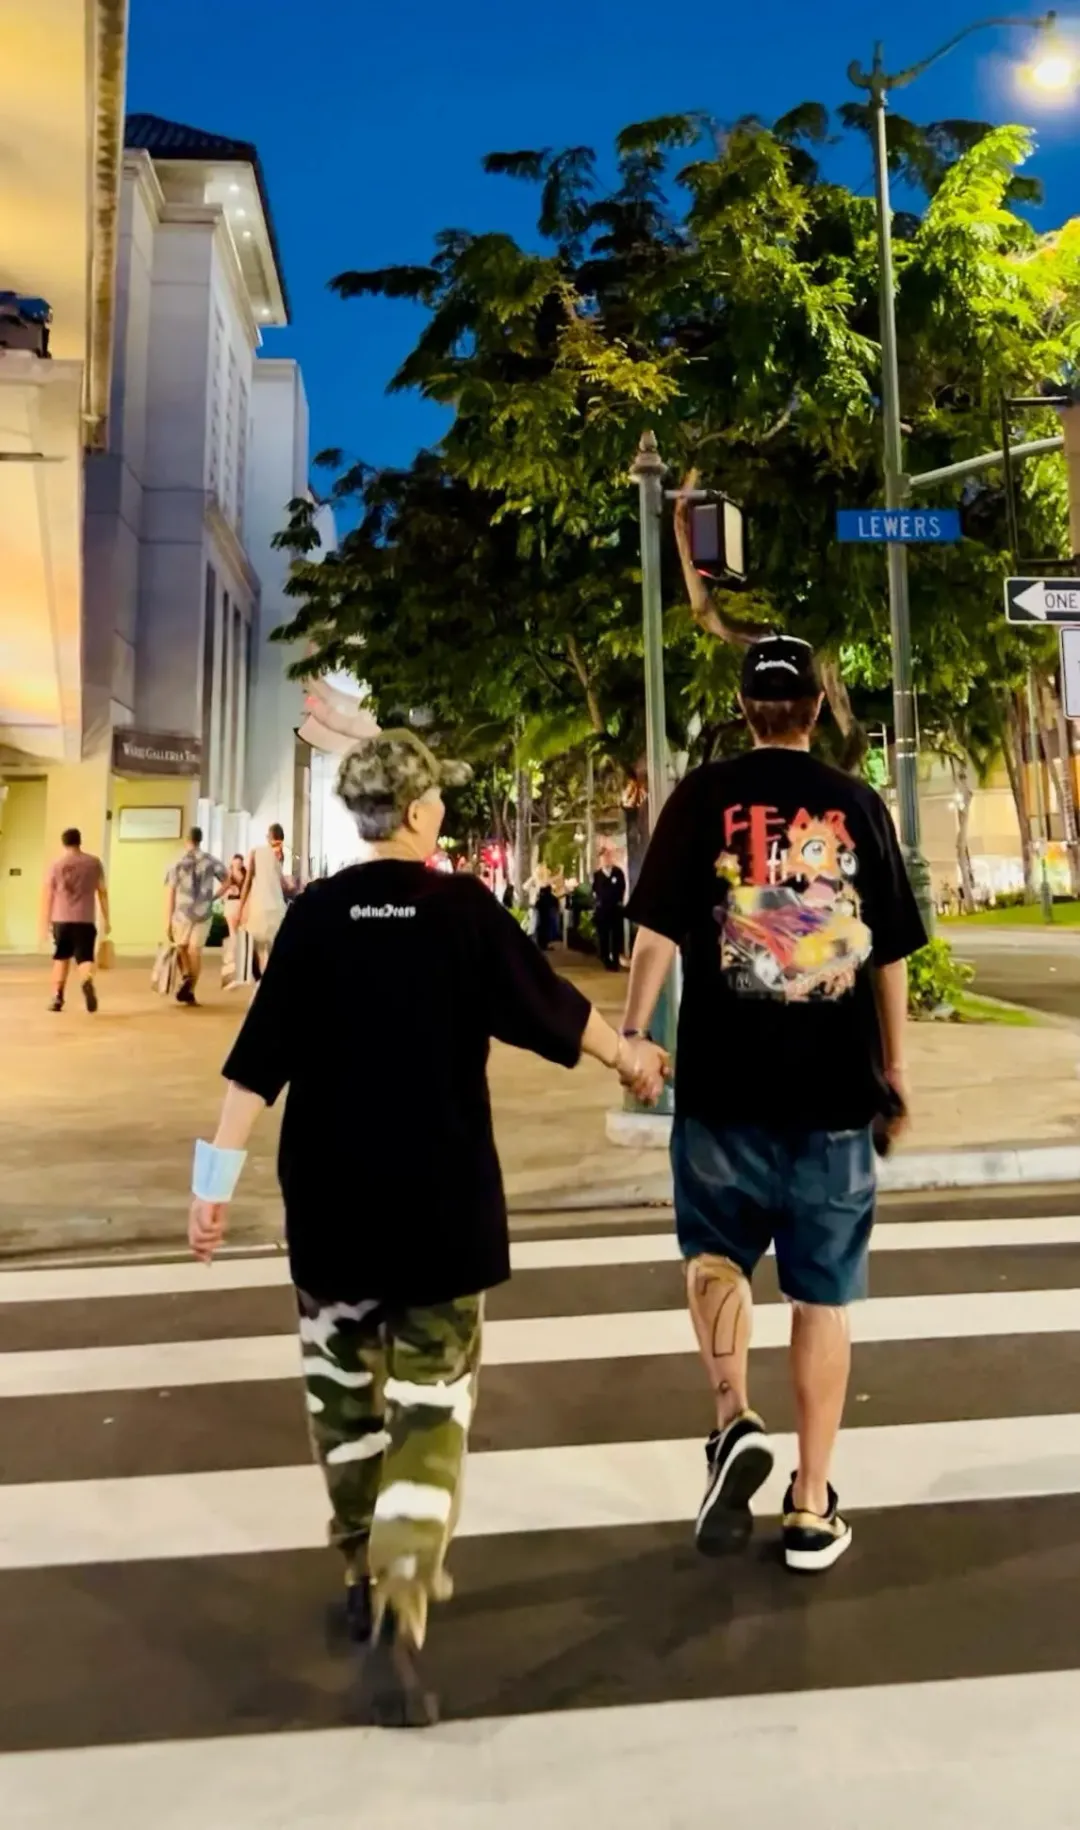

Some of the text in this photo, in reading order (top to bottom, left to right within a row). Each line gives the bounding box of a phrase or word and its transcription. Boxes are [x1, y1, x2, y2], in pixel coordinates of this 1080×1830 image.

[858, 516, 942, 538] LEWERS
[1045, 593, 1079, 609] ONE
[723, 803, 857, 886] FEAR
